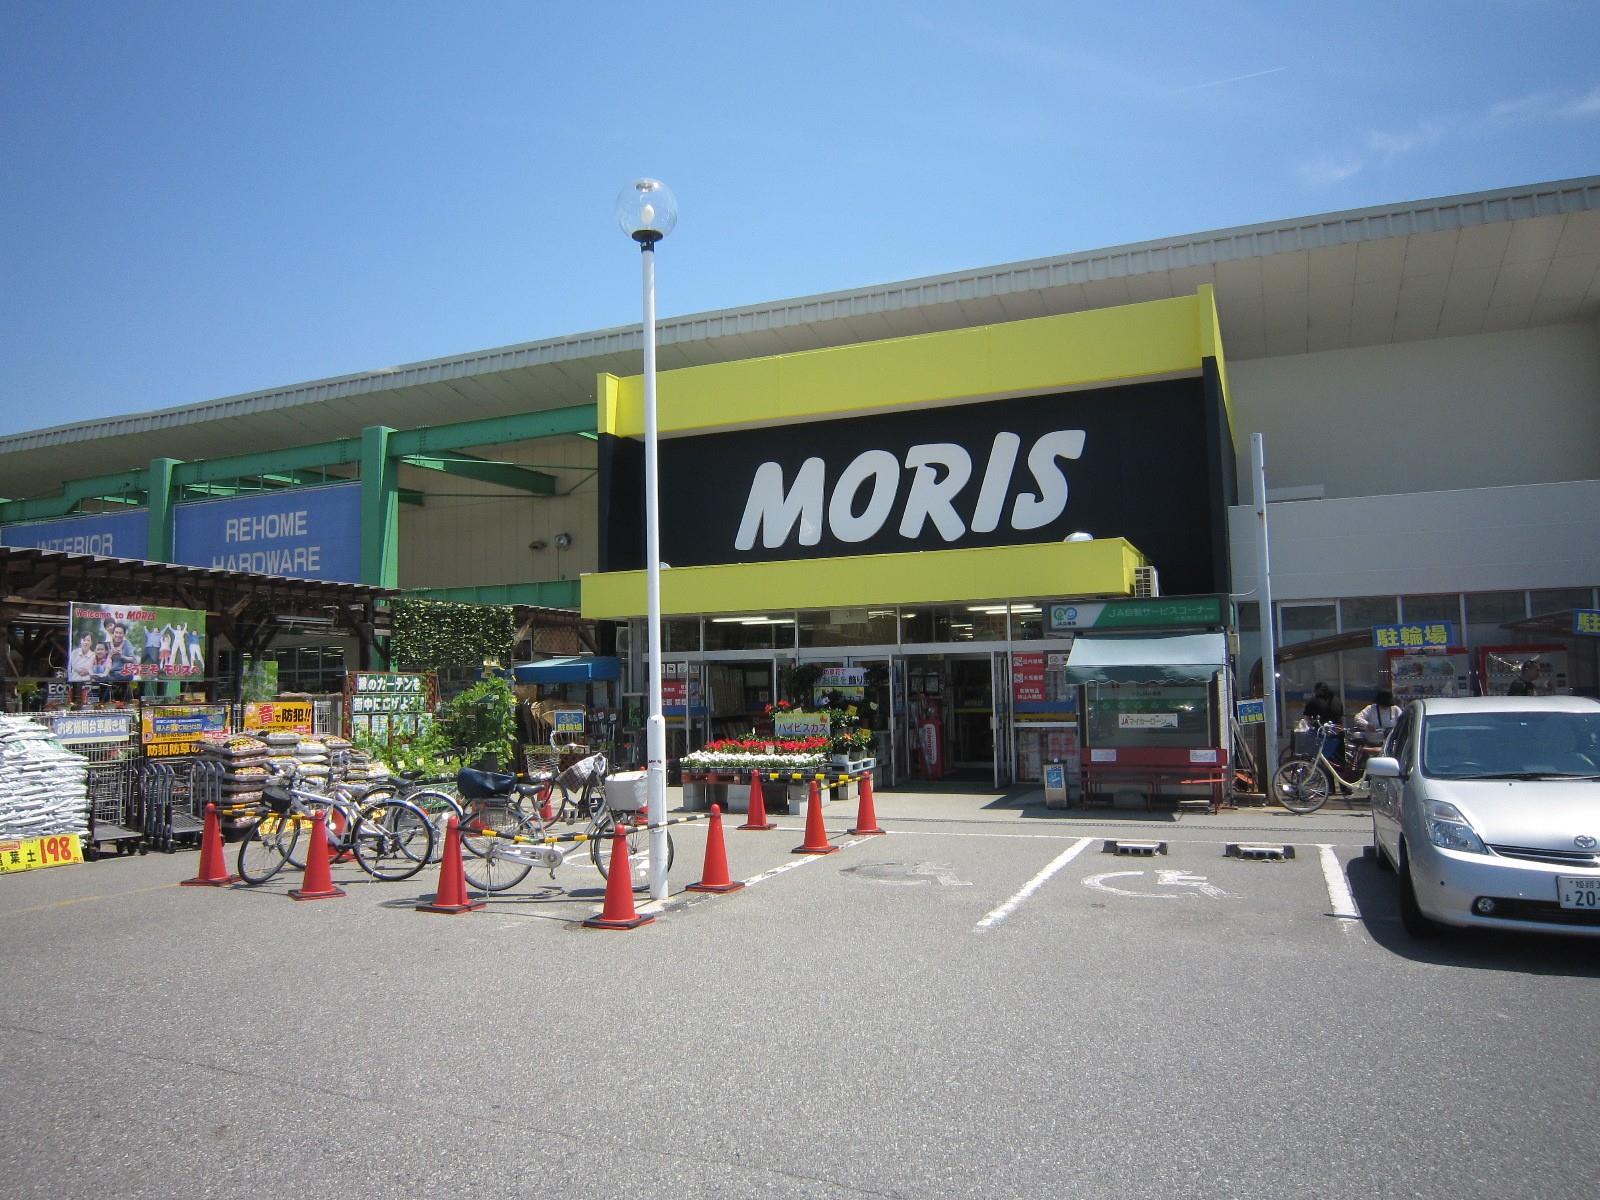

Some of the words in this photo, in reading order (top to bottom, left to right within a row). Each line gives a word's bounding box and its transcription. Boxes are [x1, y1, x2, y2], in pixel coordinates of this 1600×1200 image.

[733, 429, 1087, 551] MORIS
[225, 510, 308, 543] REHOME
[212, 546, 321, 574] HARDWARE
[74, 607, 111, 619] Welcome
[114, 609, 125, 619] to
[126, 610, 157, 621] MORIS
[1376, 624, 1447, 647] 駐輪場
[120, 663, 159, 676] ようこそ
[164, 664, 201, 676] モリスへ
[57, 718, 127, 736] お客様用台車置き場
[147, 742, 204, 757] 防犯防草の
[40, 836, 72, 864] 198
